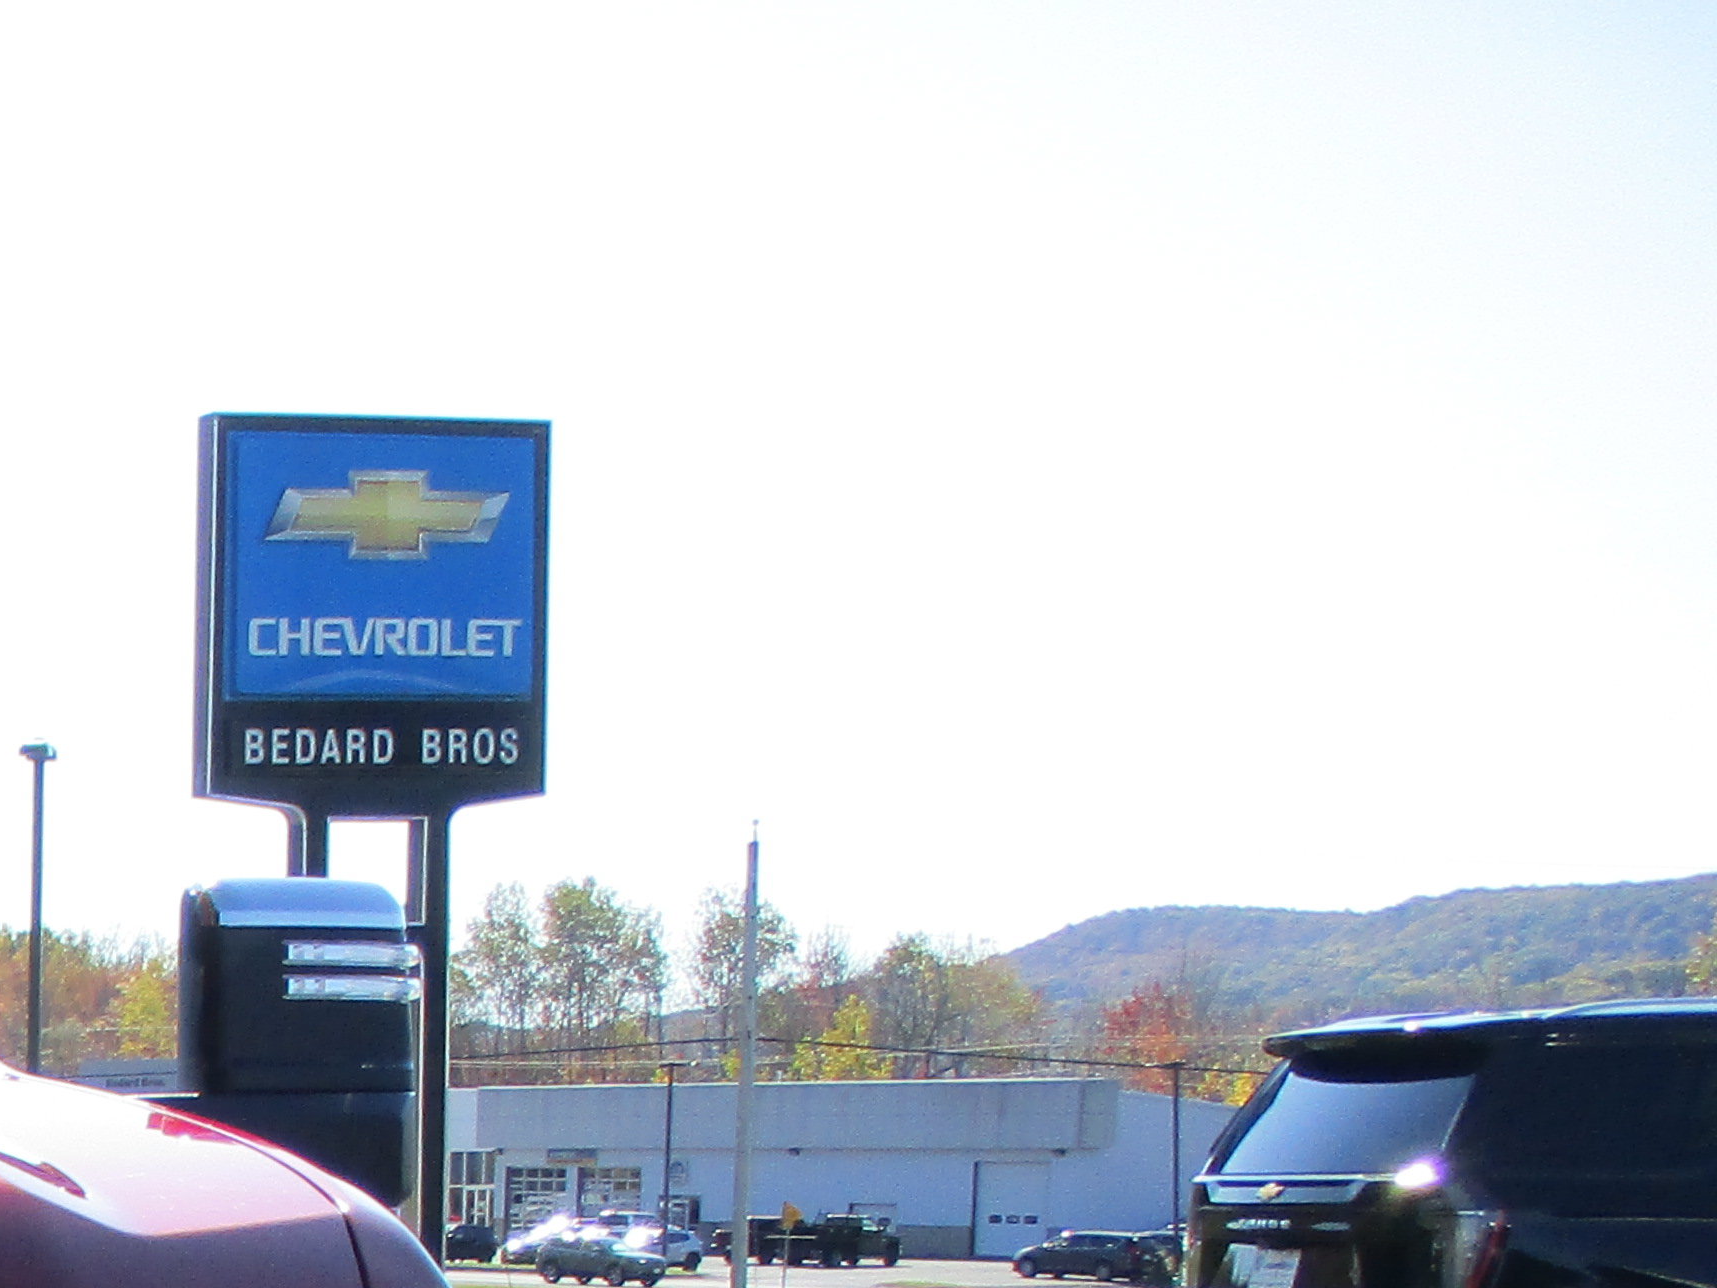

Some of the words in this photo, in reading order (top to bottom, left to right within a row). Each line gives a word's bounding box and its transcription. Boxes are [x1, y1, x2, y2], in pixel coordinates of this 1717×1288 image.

[248, 618, 522, 657] CHEVROLET
[243, 728, 395, 766] BEDARD
[421, 727, 520, 766] BROS
